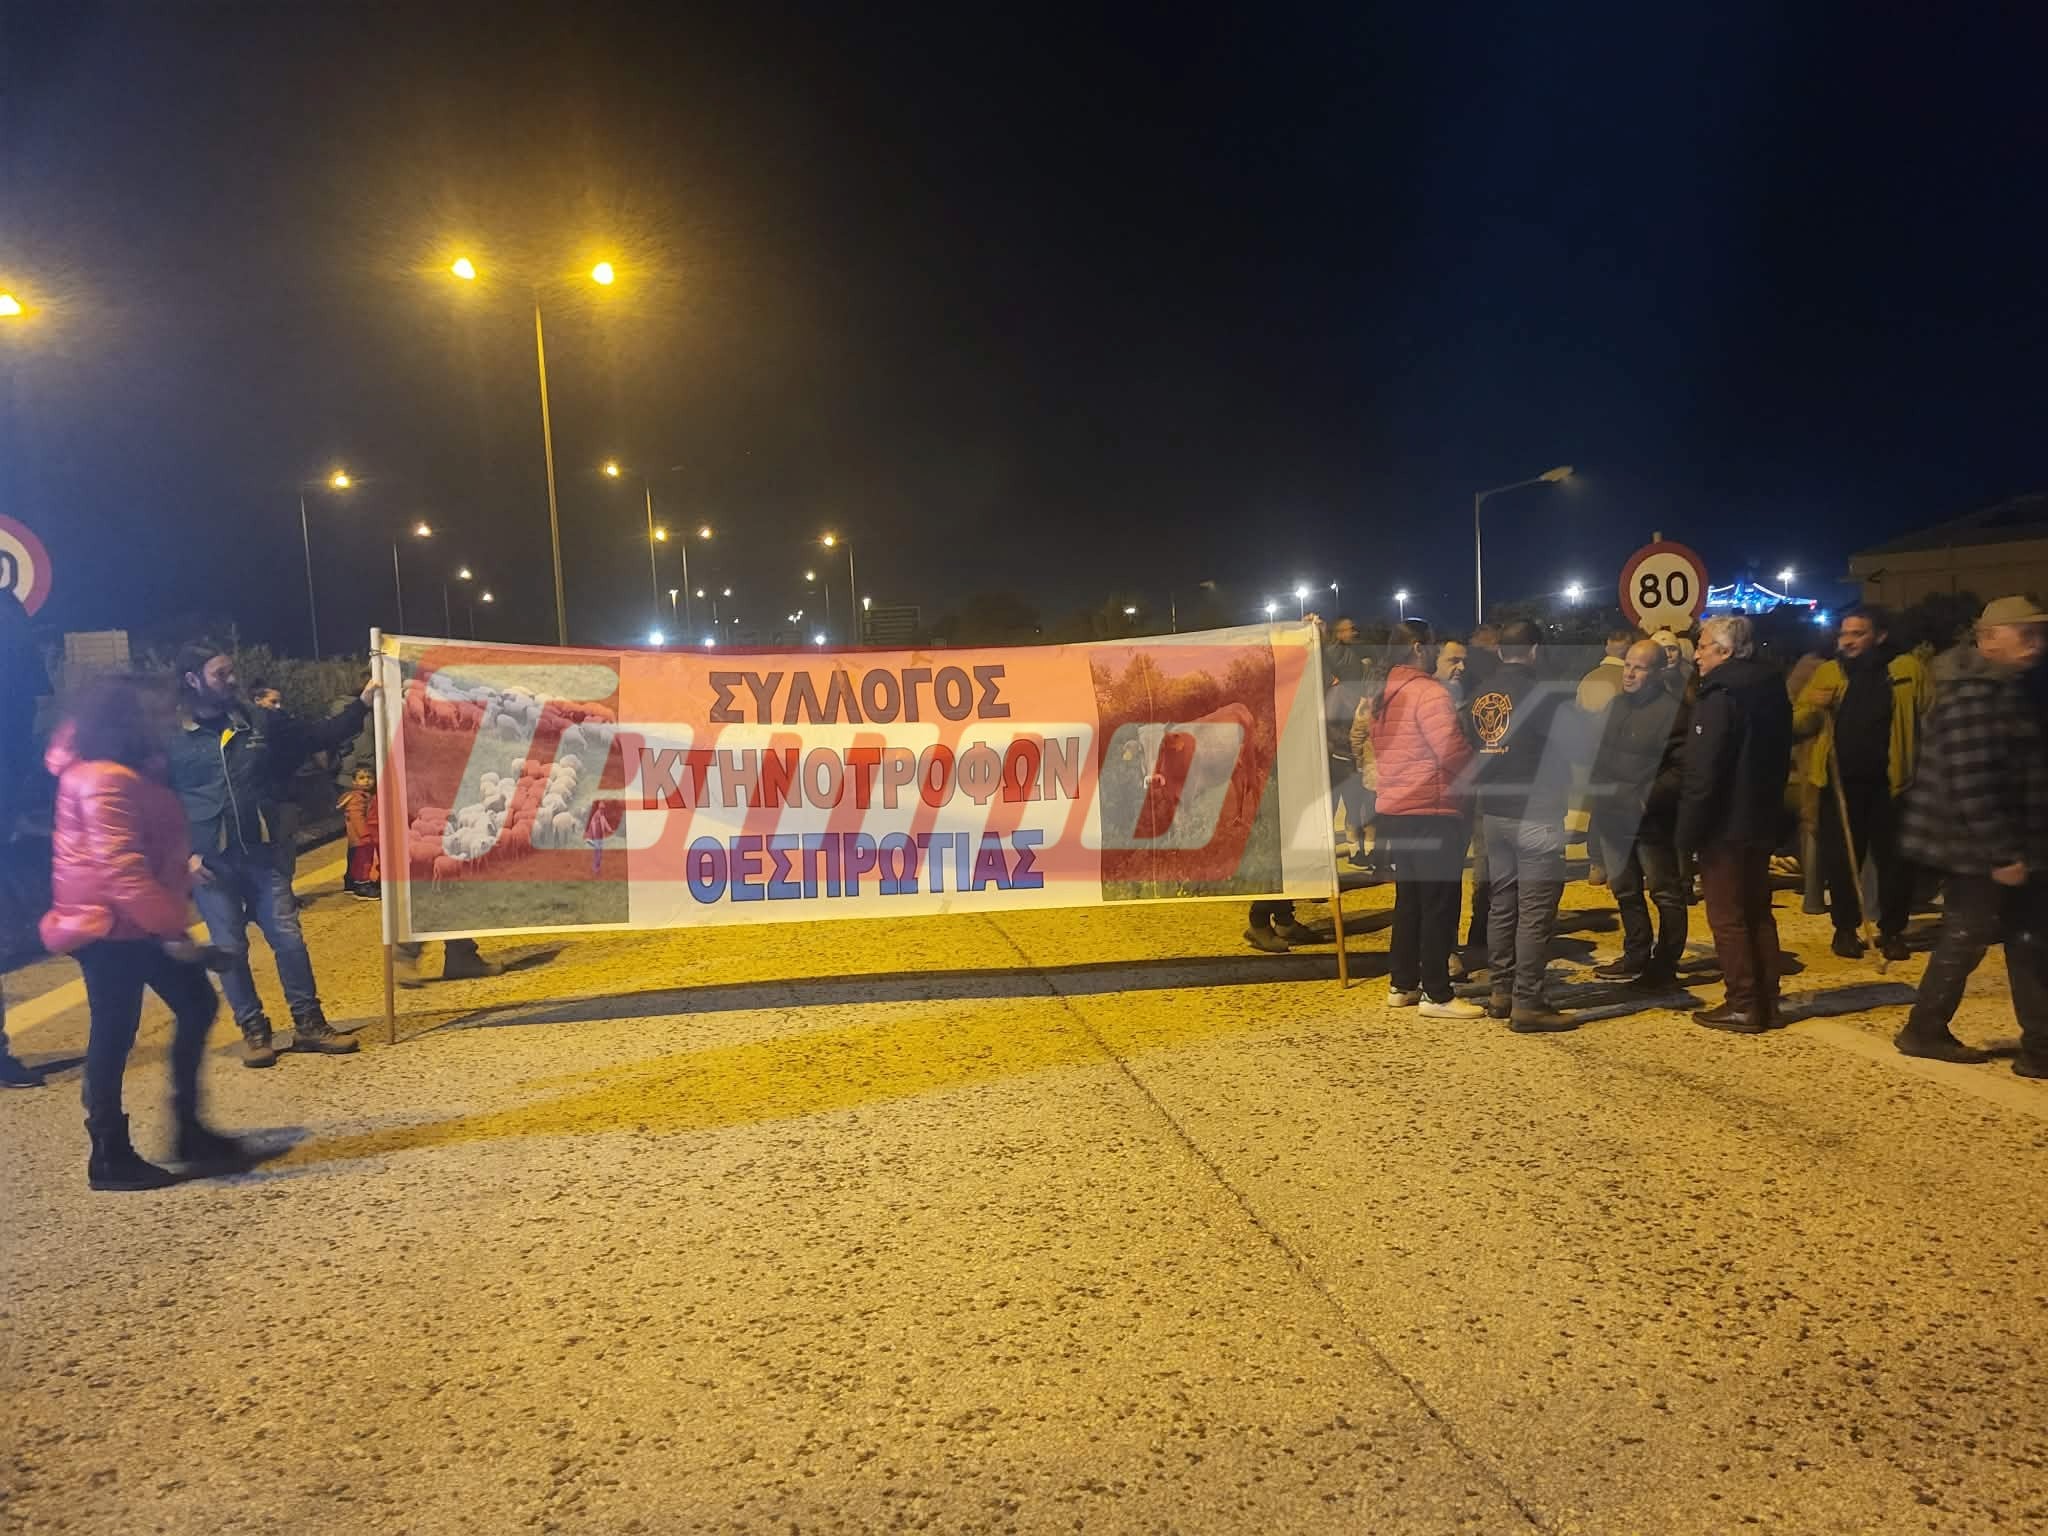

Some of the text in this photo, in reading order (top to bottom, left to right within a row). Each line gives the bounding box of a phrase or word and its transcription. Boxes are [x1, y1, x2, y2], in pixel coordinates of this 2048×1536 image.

[1639, 571, 1689, 609] 80
[709, 664, 1010, 725] ΣΥΛΛΟΓΟΣ
[638, 736, 1080, 810] ΚΤΗΝΟΤΡΟΦΩΝ
[686, 828, 1045, 903] ΘΕΣΠΡΩΤΙΑΣ
